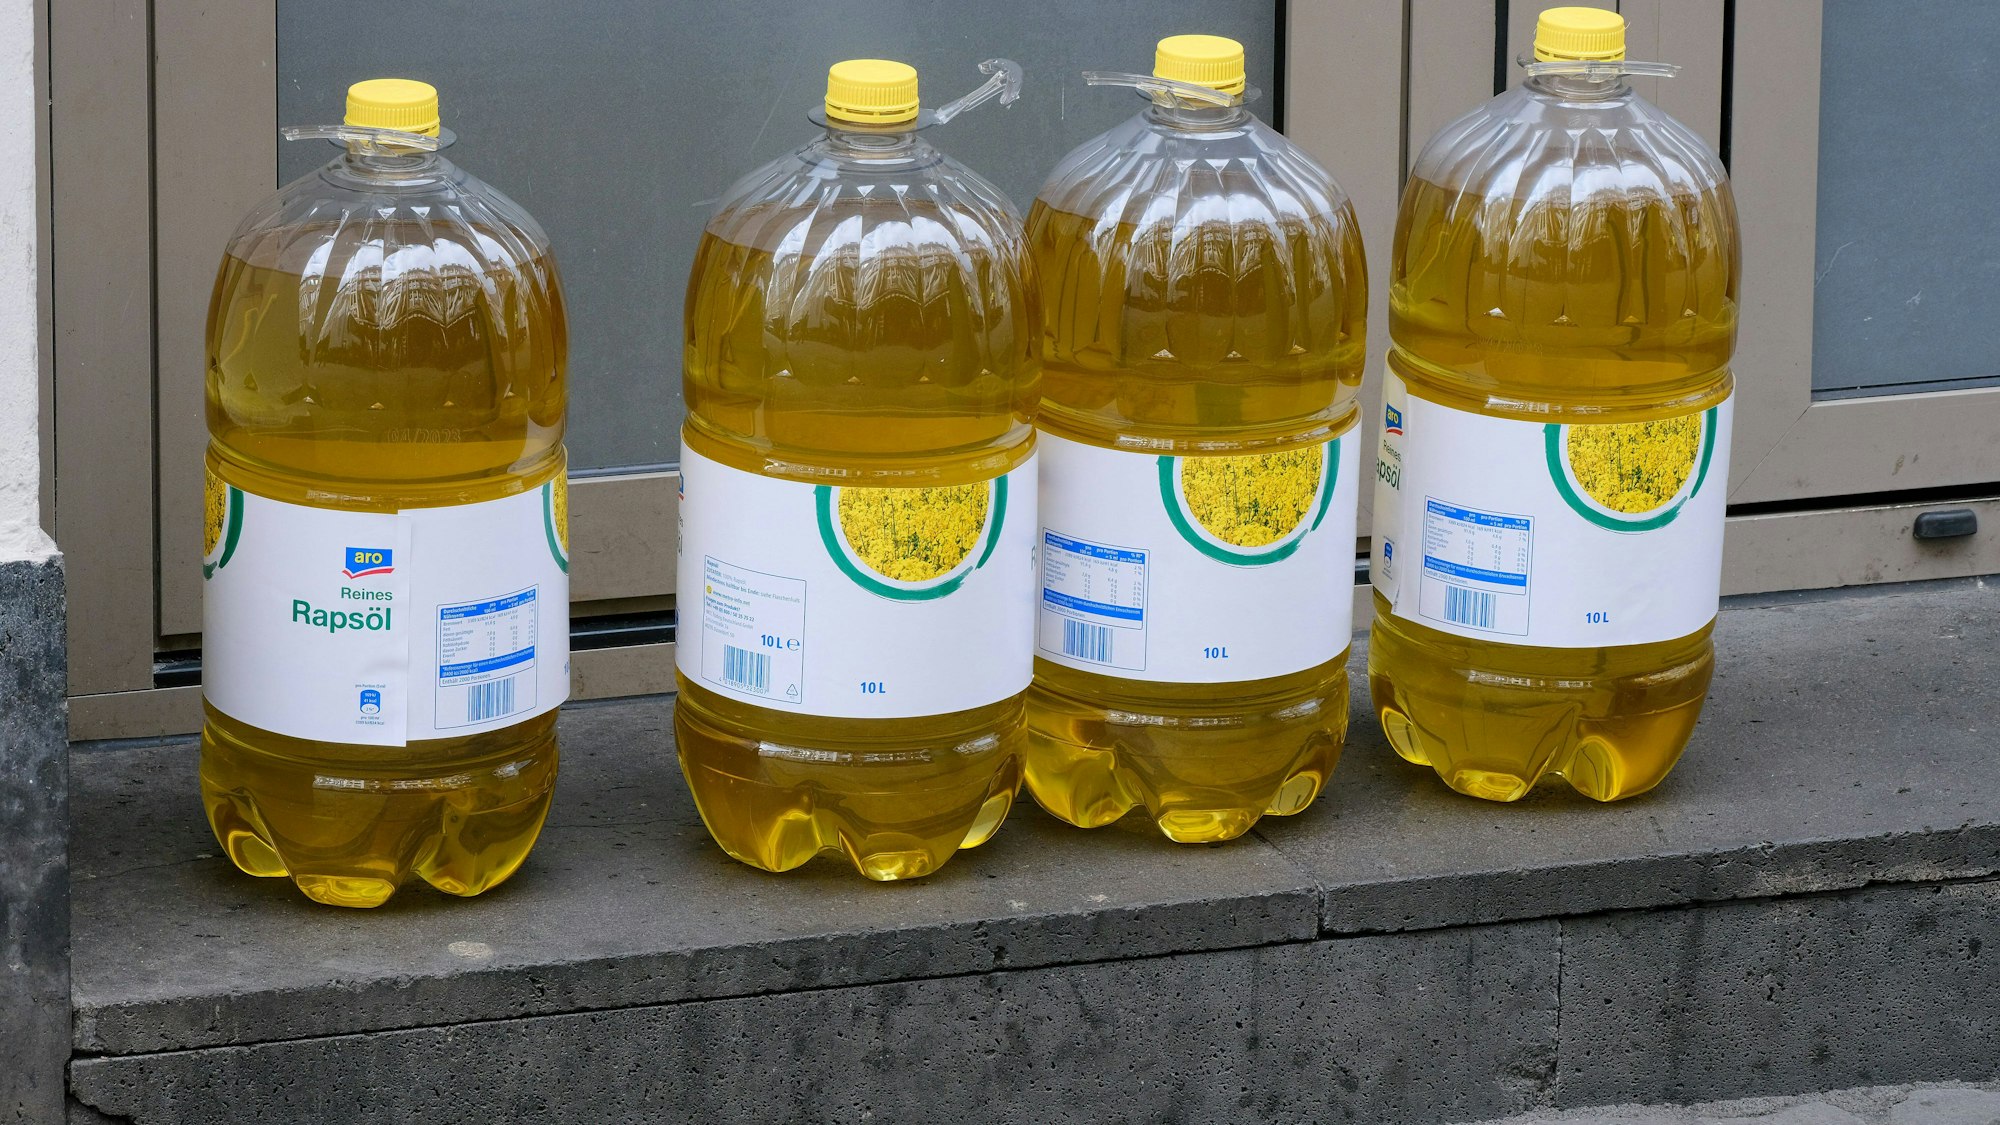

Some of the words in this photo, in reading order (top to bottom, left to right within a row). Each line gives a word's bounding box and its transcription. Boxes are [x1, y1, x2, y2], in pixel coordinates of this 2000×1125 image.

[1387, 409, 1399, 424] aro
[1383, 440, 1401, 462] Reines
[354, 551, 383, 564] aro
[341, 587, 393, 601] Reines
[292, 599, 391, 634] Rapsöl
[1586, 612, 1600, 624] 10
[1603, 612, 1609, 623] L
[761, 634, 774, 647] 10
[776, 637, 783, 649] L
[1204, 647, 1219, 659] 10
[1222, 647, 1228, 658] L
[861, 682, 876, 694] 10
[879, 682, 886, 694] L
